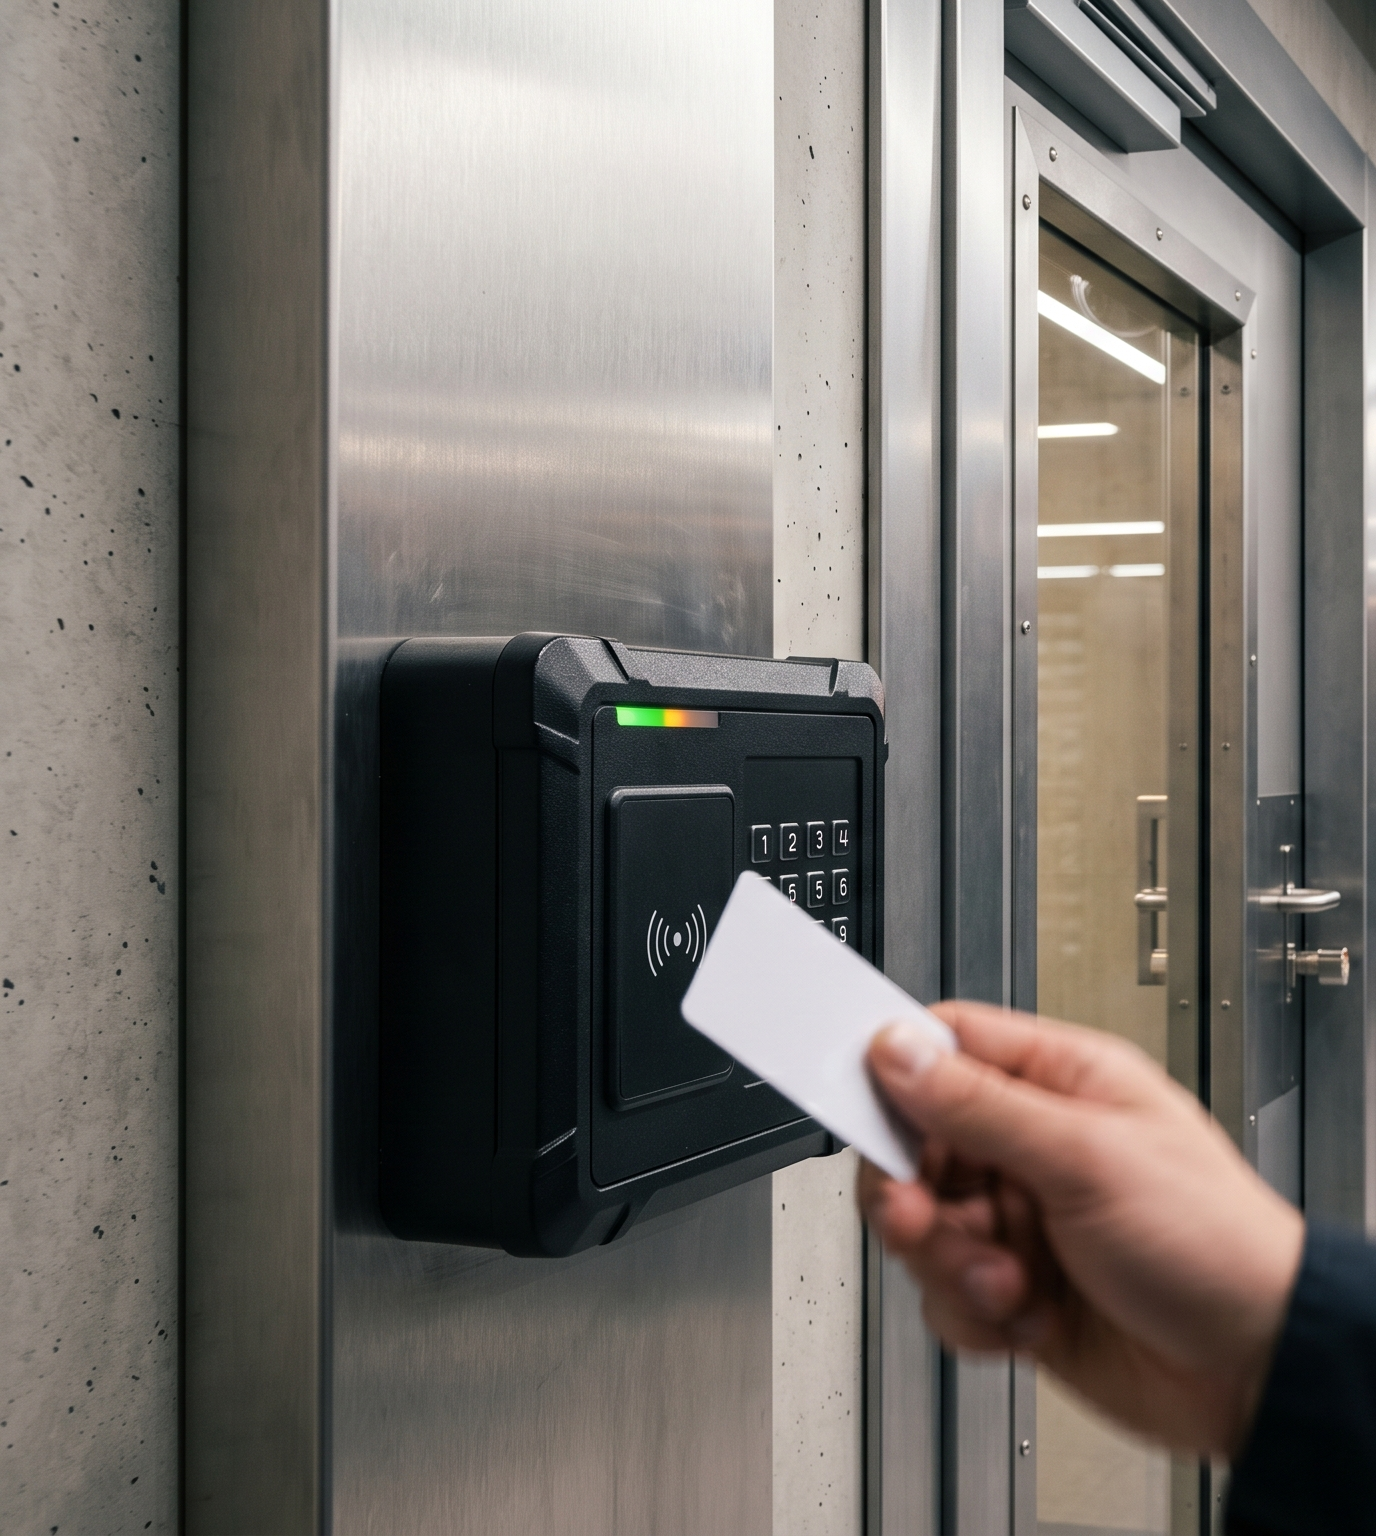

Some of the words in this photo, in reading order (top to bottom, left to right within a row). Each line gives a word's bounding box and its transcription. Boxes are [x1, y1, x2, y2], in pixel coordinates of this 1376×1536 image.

[761, 835, 767, 855] 1
[788, 833, 797, 852] 2
[816, 830, 824, 849] 3
[839, 829, 849, 847] 4
[815, 880, 823, 899] 5
[839, 877, 848, 896] 6
[839, 925, 847, 943] 9
